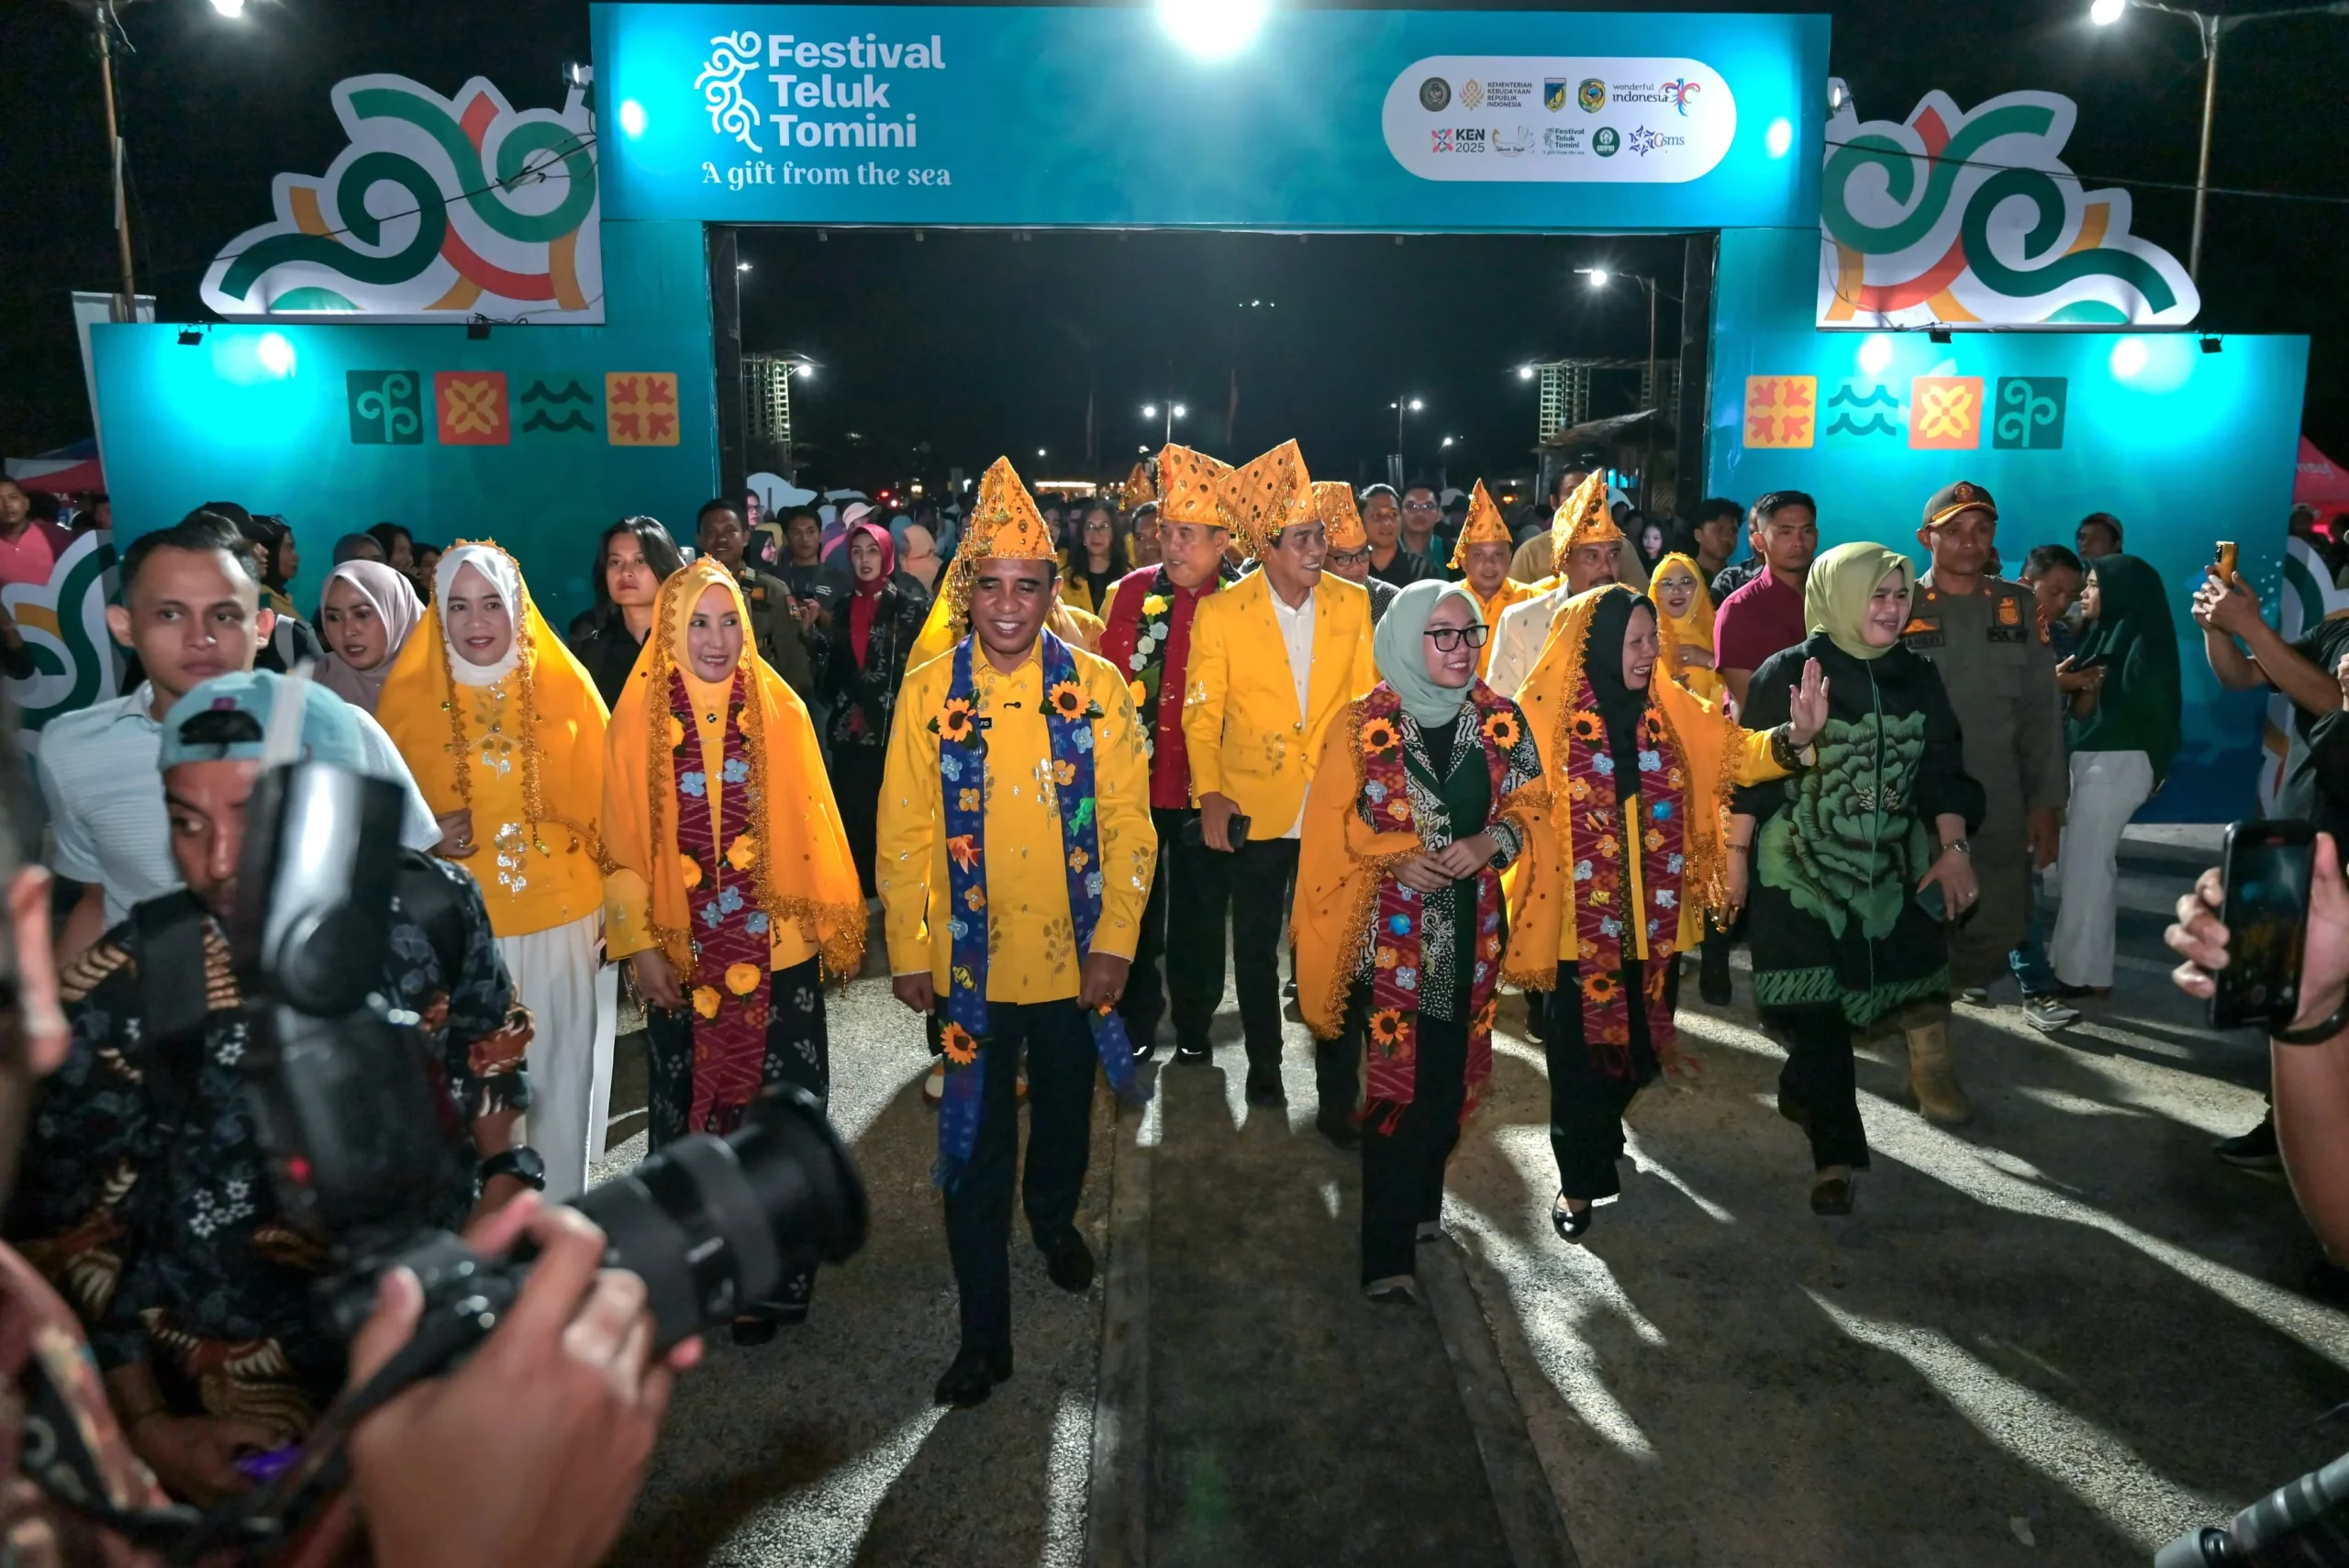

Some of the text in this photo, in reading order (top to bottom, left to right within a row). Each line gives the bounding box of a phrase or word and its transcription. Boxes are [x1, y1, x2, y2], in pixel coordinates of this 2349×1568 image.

[768, 33, 946, 69] Festival
[768, 74, 891, 108] Teluk
[1612, 92, 1669, 103] indonesia
[769, 113, 917, 148] Tomini
[1455, 128, 1486, 141] KEN
[1455, 142, 1486, 153] 2025
[702, 161, 952, 191] A gift from the sea
